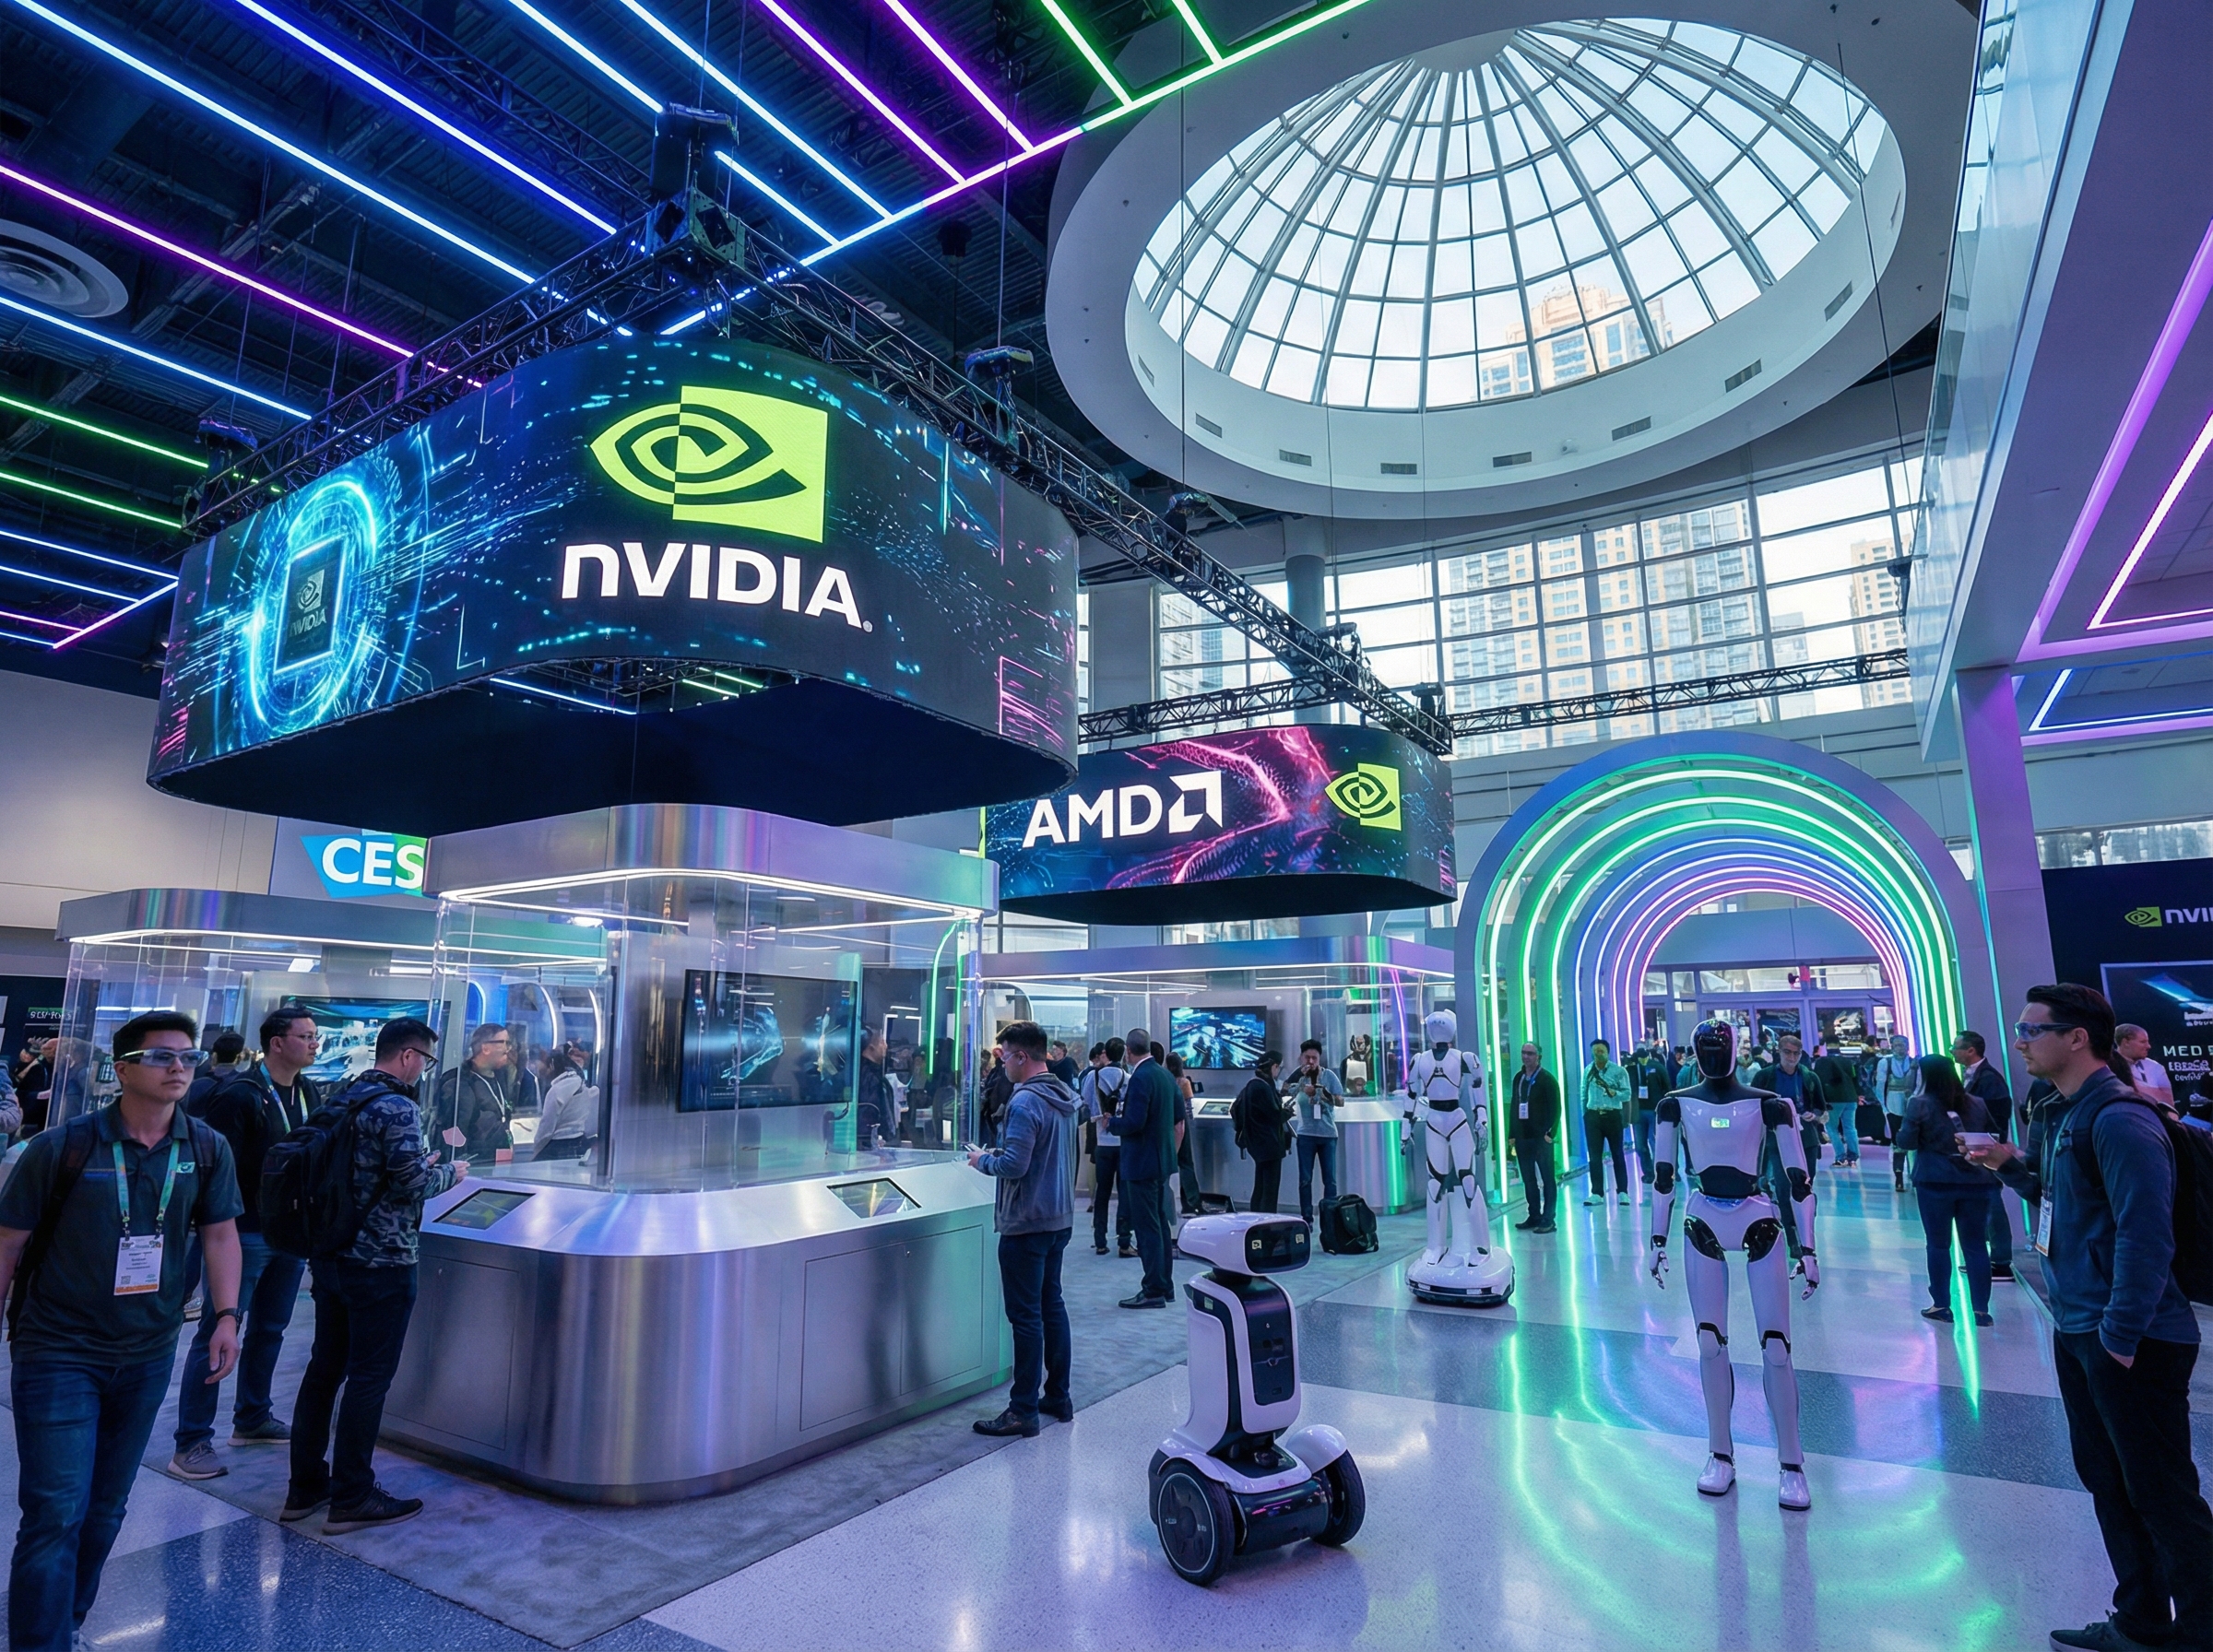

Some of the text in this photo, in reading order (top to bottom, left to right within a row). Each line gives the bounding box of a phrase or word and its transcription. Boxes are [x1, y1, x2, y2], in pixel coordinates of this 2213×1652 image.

[1022, 785, 1163, 848] AMD
[322, 838, 424, 890] CES
[2165, 907, 2213, 924] nVI
